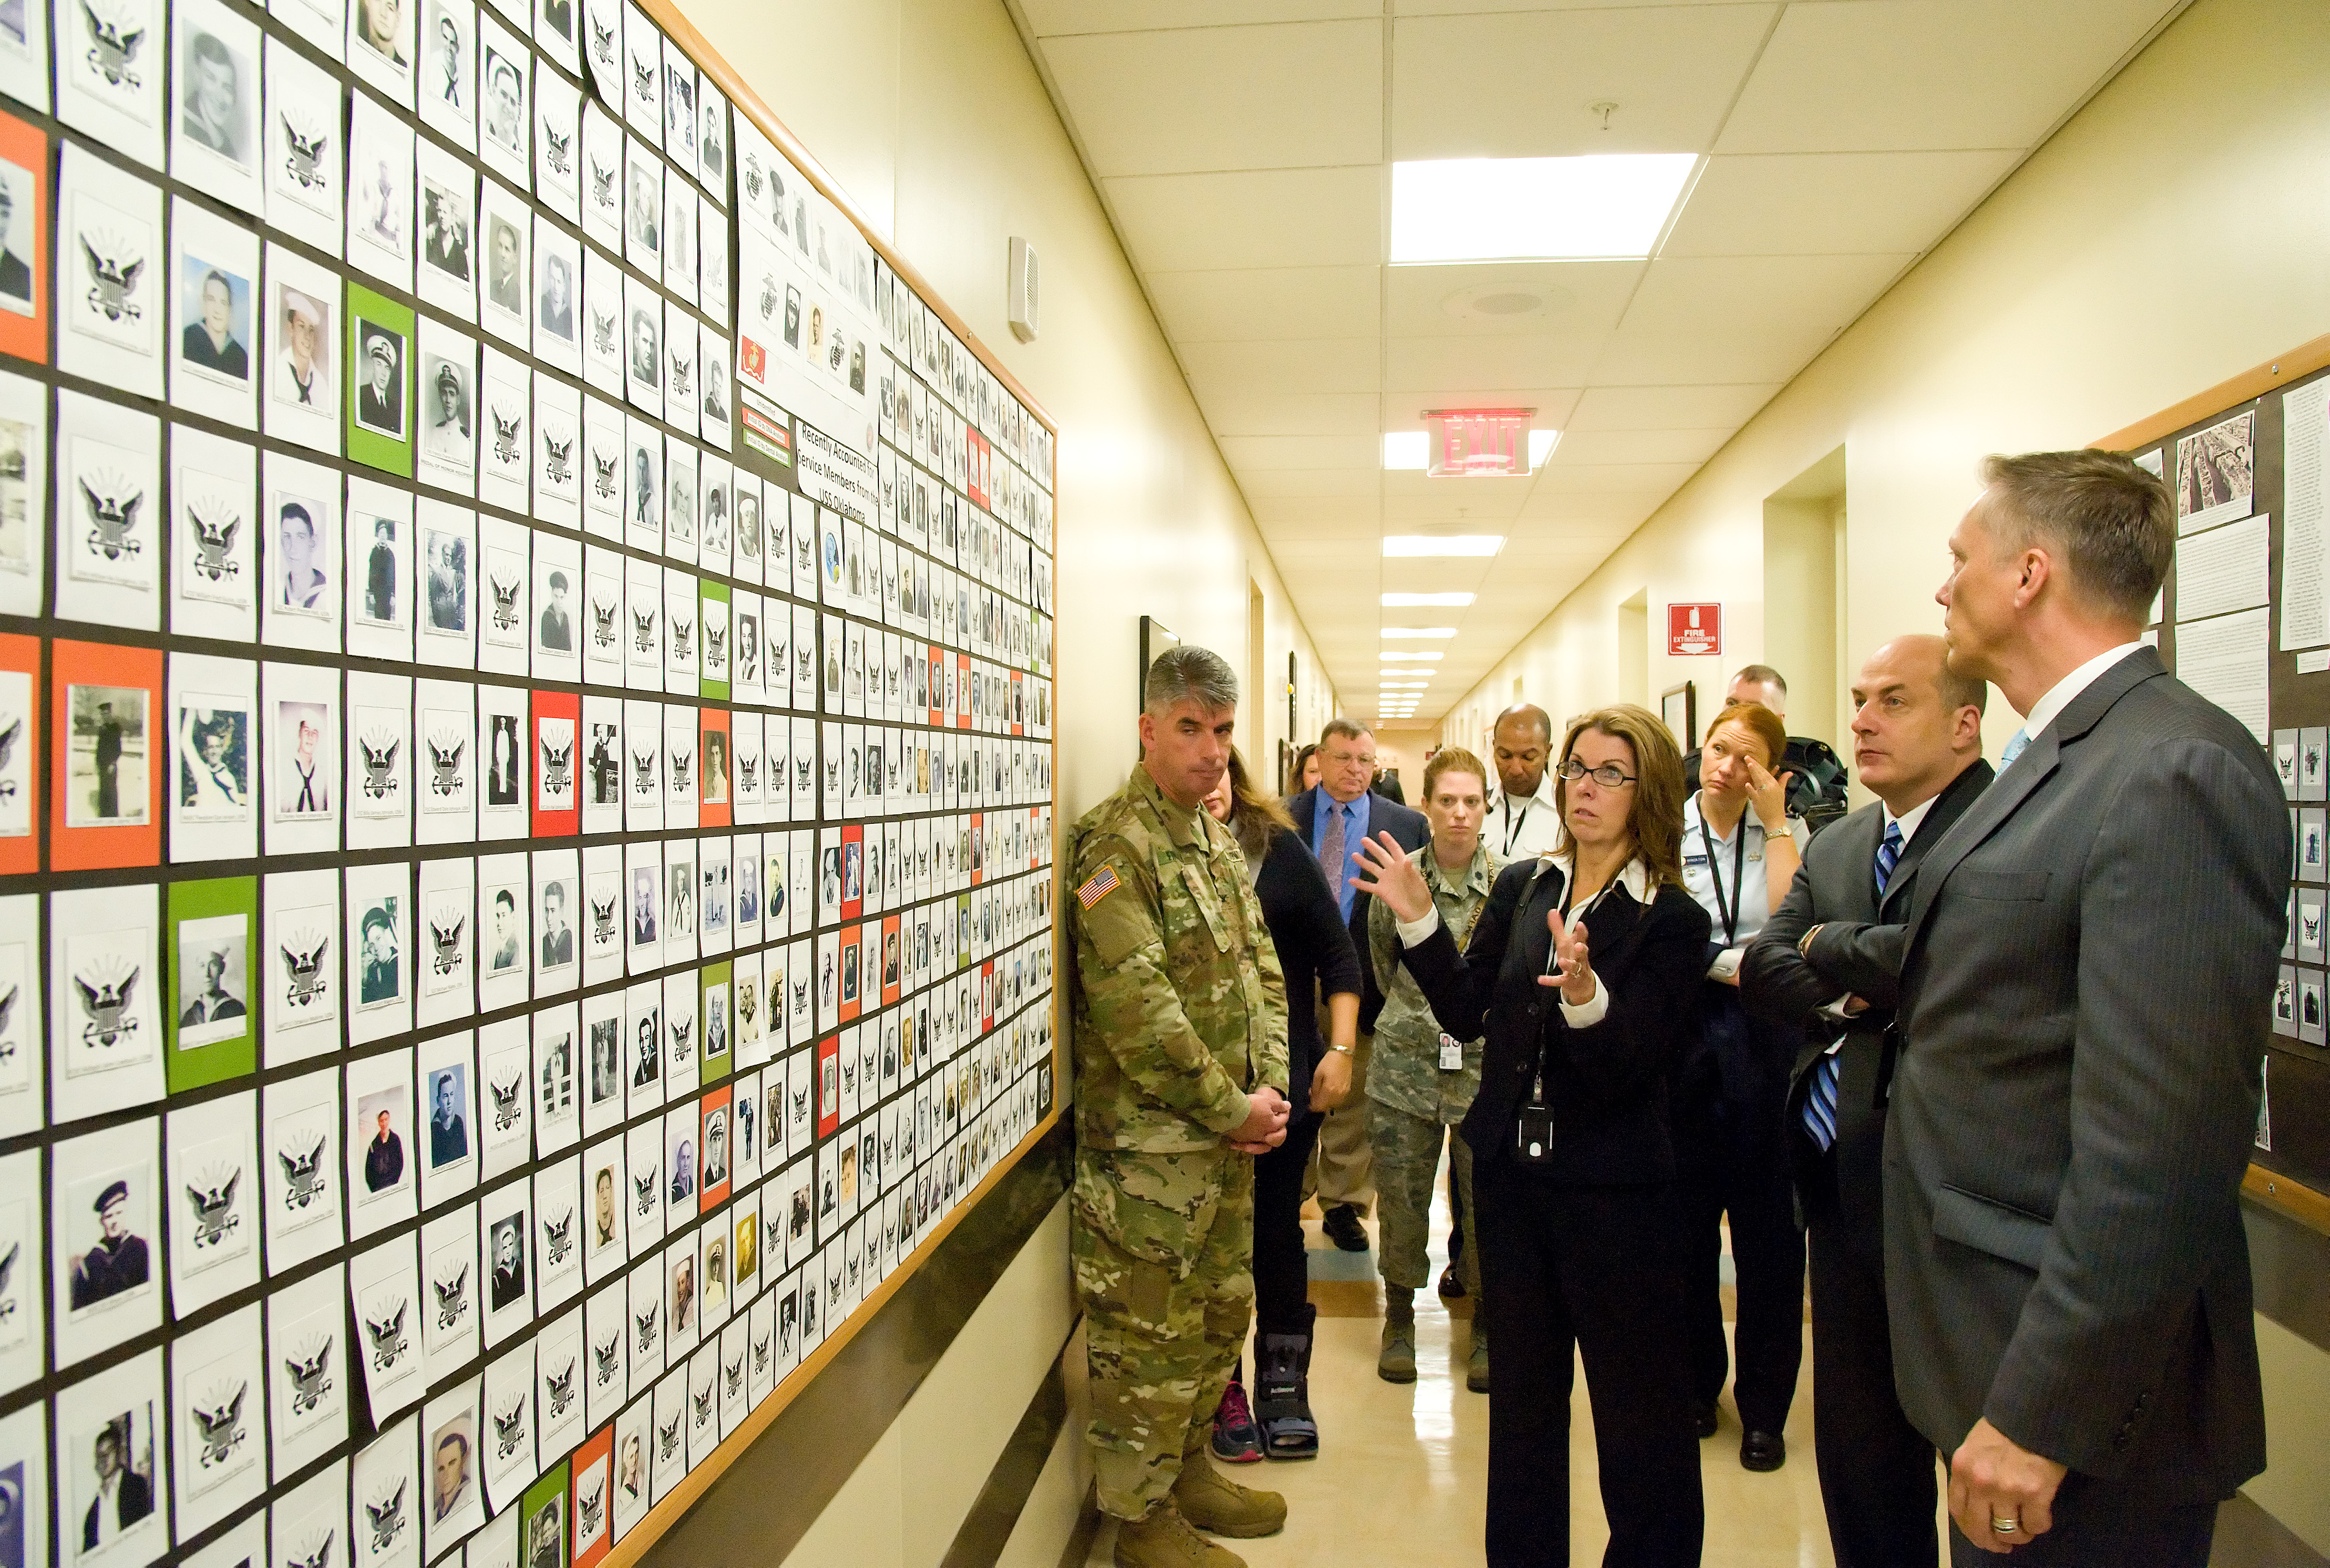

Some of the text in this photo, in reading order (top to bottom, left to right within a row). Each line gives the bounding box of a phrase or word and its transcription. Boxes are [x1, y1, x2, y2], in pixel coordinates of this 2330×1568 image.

[803, 424, 832, 457] Recently
[834, 442, 866, 473] Accounted
[1443, 417, 1522, 471] EXIT
[798, 448, 822, 476] Service
[824, 463, 855, 493] Members
[857, 480, 870, 501] from
[819, 488, 865, 523] USS Oklahoma
